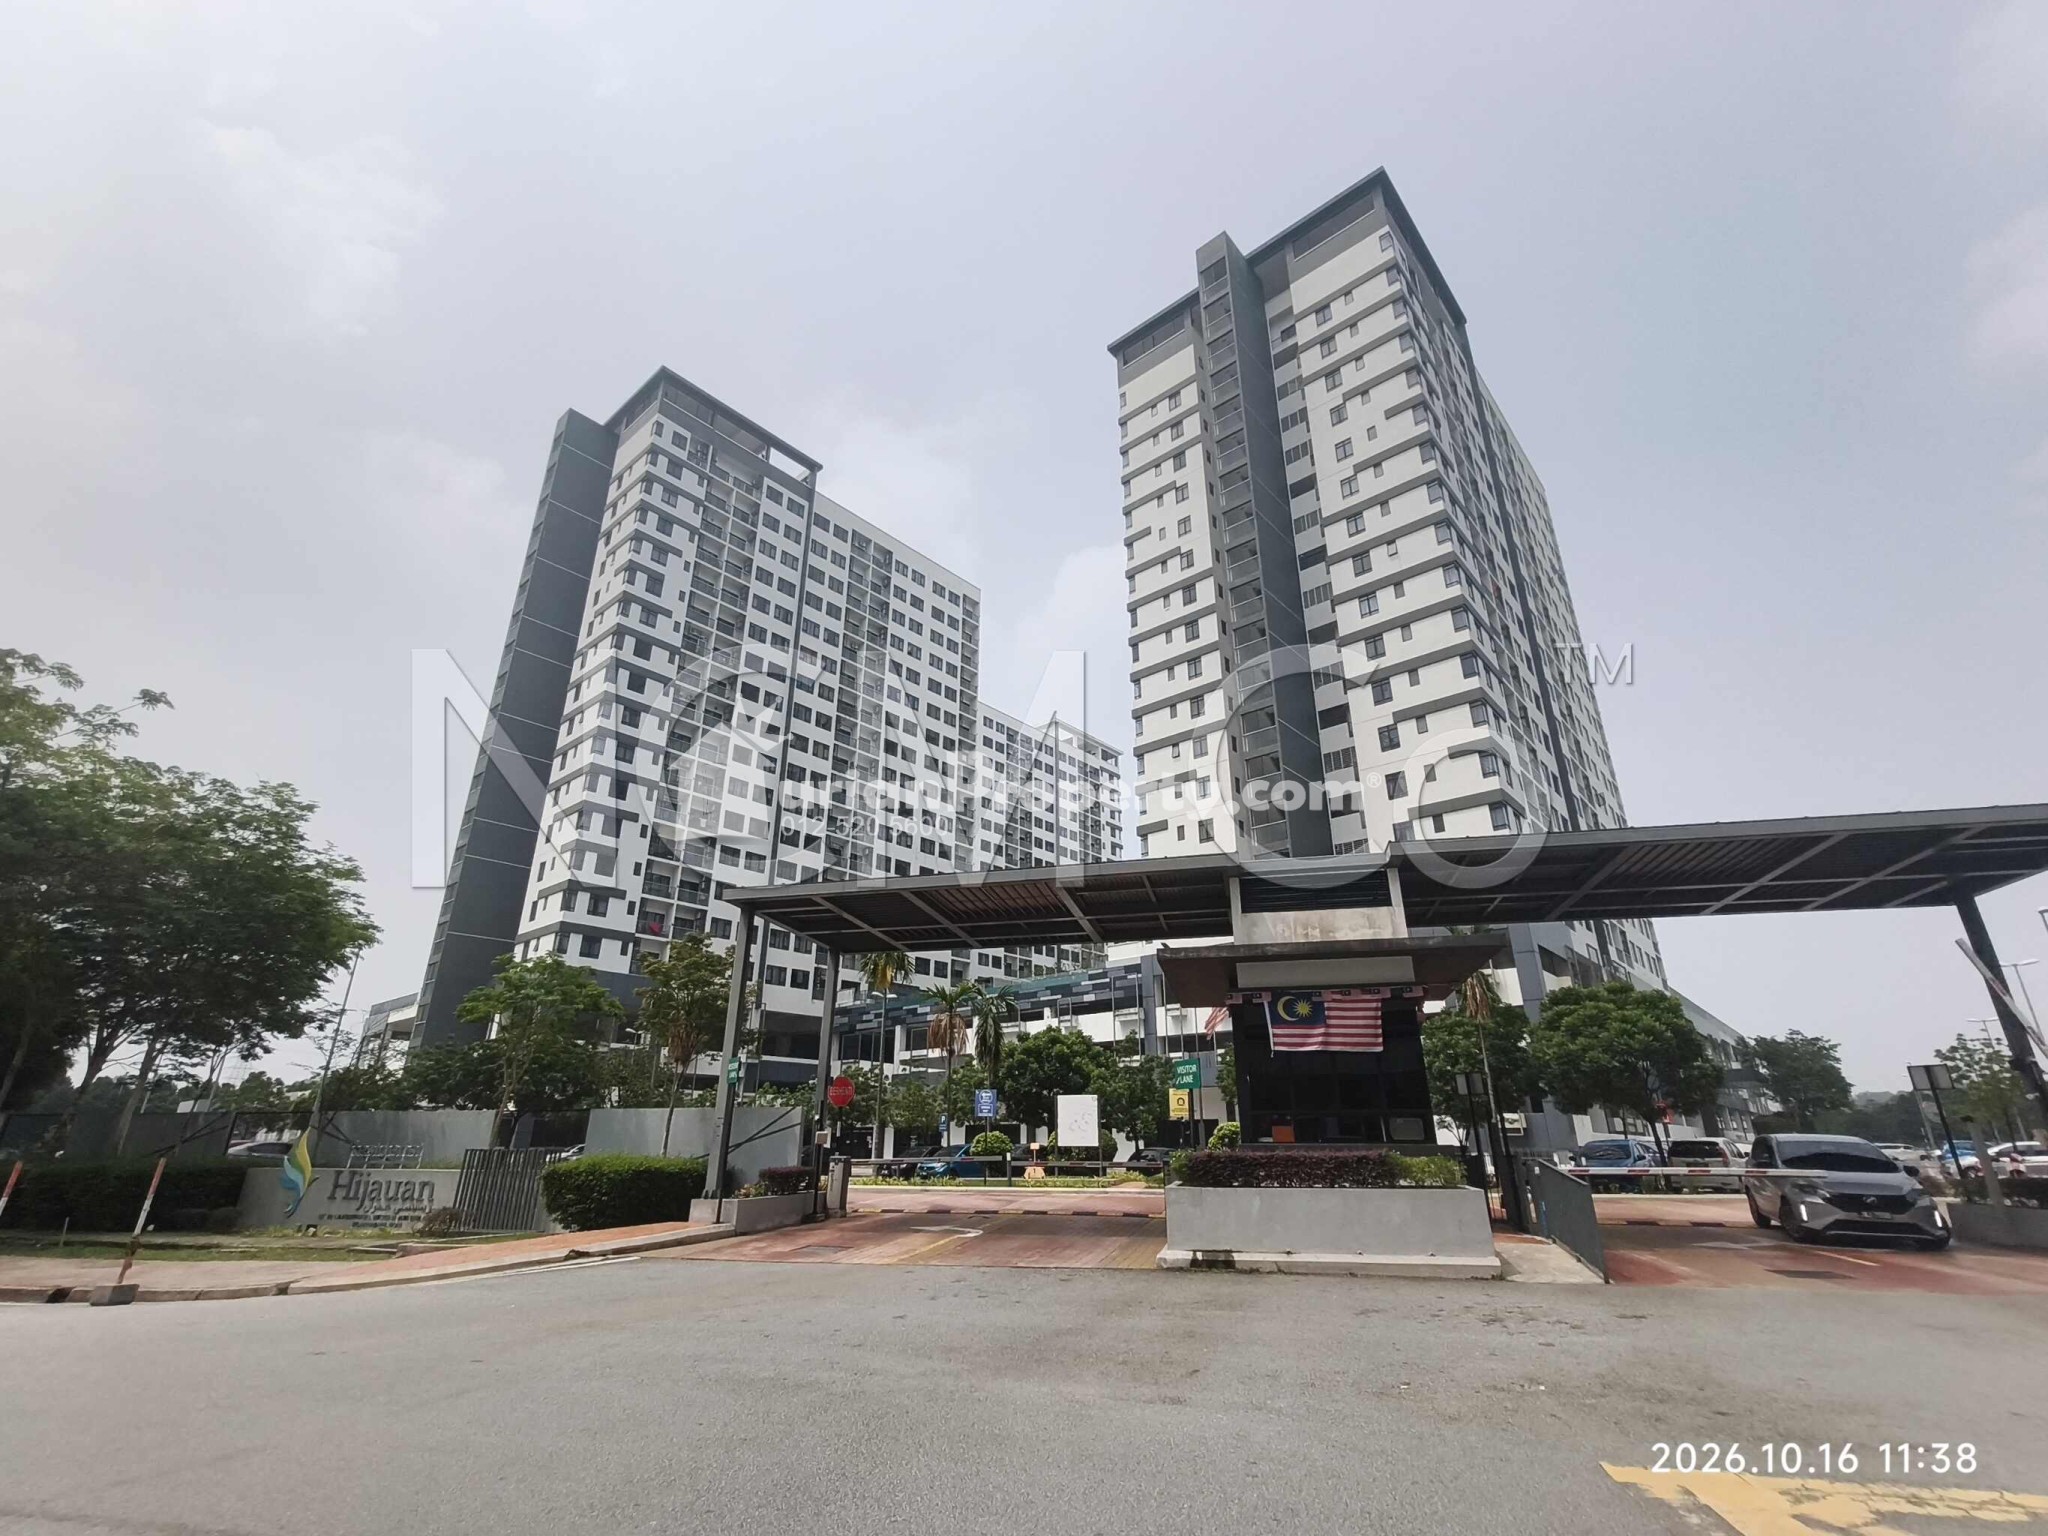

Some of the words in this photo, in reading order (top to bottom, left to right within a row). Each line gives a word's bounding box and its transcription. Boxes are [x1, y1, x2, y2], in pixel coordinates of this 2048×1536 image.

[1176, 1064, 1197, 1074] VISITOR
[1180, 1075, 1193, 1084] LANE
[326, 1169, 435, 1211] Hijauan
